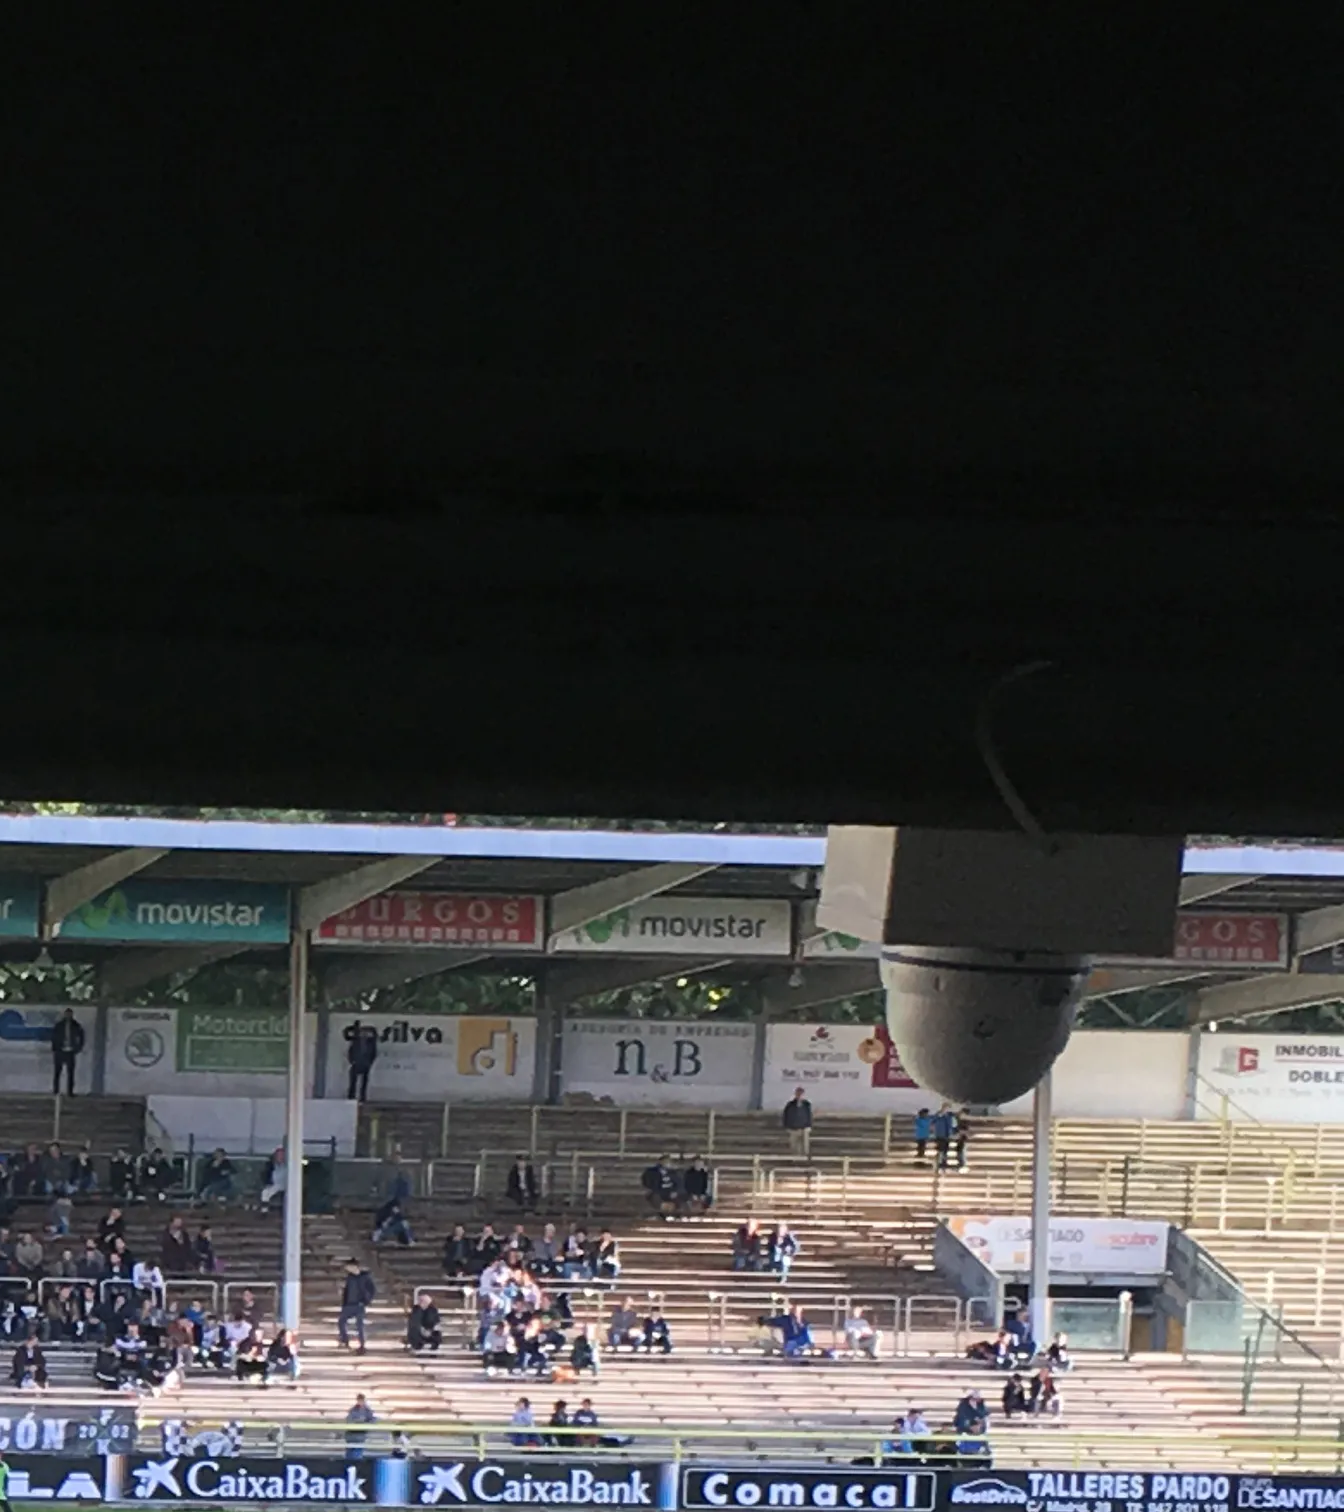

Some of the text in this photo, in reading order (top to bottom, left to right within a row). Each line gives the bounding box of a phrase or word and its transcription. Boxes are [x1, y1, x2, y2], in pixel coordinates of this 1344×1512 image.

[136, 900, 264, 927] movistar
[339, 895, 520, 924] URGOS
[638, 910, 767, 939] movistar
[1275, 1045, 1344, 1058] INMOBIL
[186, 1459, 367, 1500] CaixaBank
[472, 1466, 651, 1505] CaixaBank
[703, 1472, 917, 1508] Comacal
[1028, 1473, 1230, 1501] TALLERES PARDO
